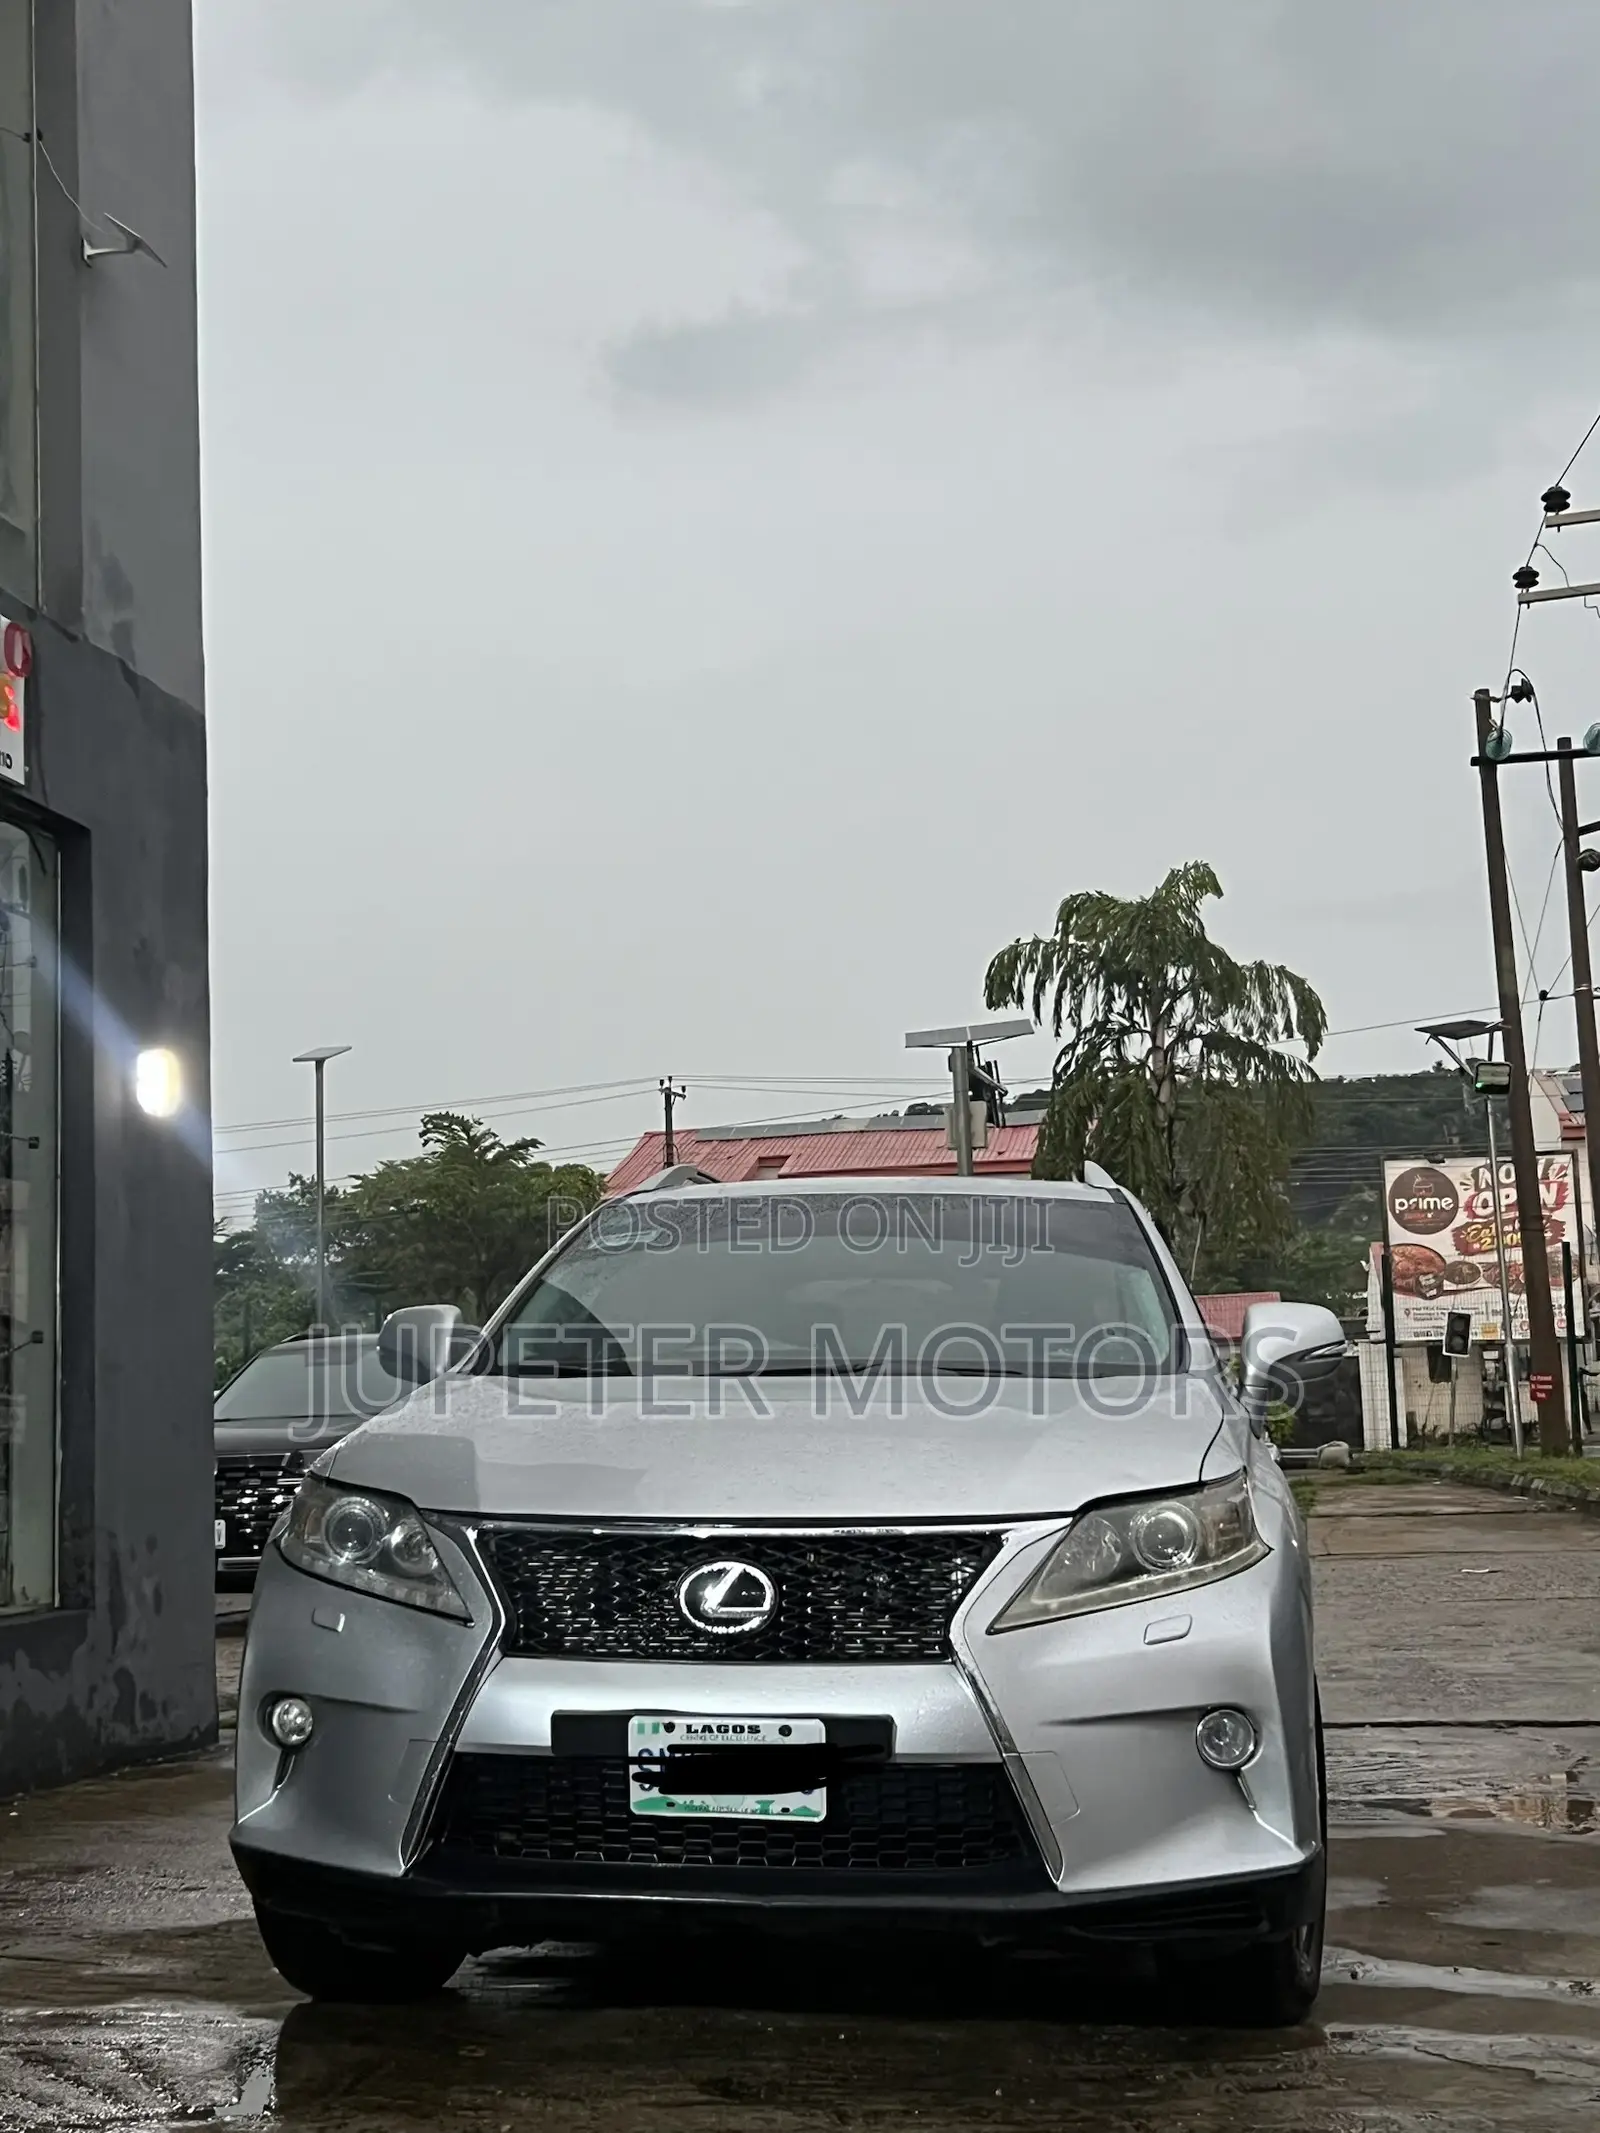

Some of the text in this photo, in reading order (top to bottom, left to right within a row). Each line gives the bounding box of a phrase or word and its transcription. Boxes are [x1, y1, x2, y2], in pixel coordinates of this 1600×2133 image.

[1395, 1197, 1454, 1214] prime
[1472, 1183, 1558, 1216] OPN
[686, 1724, 761, 1734] LAGOS
